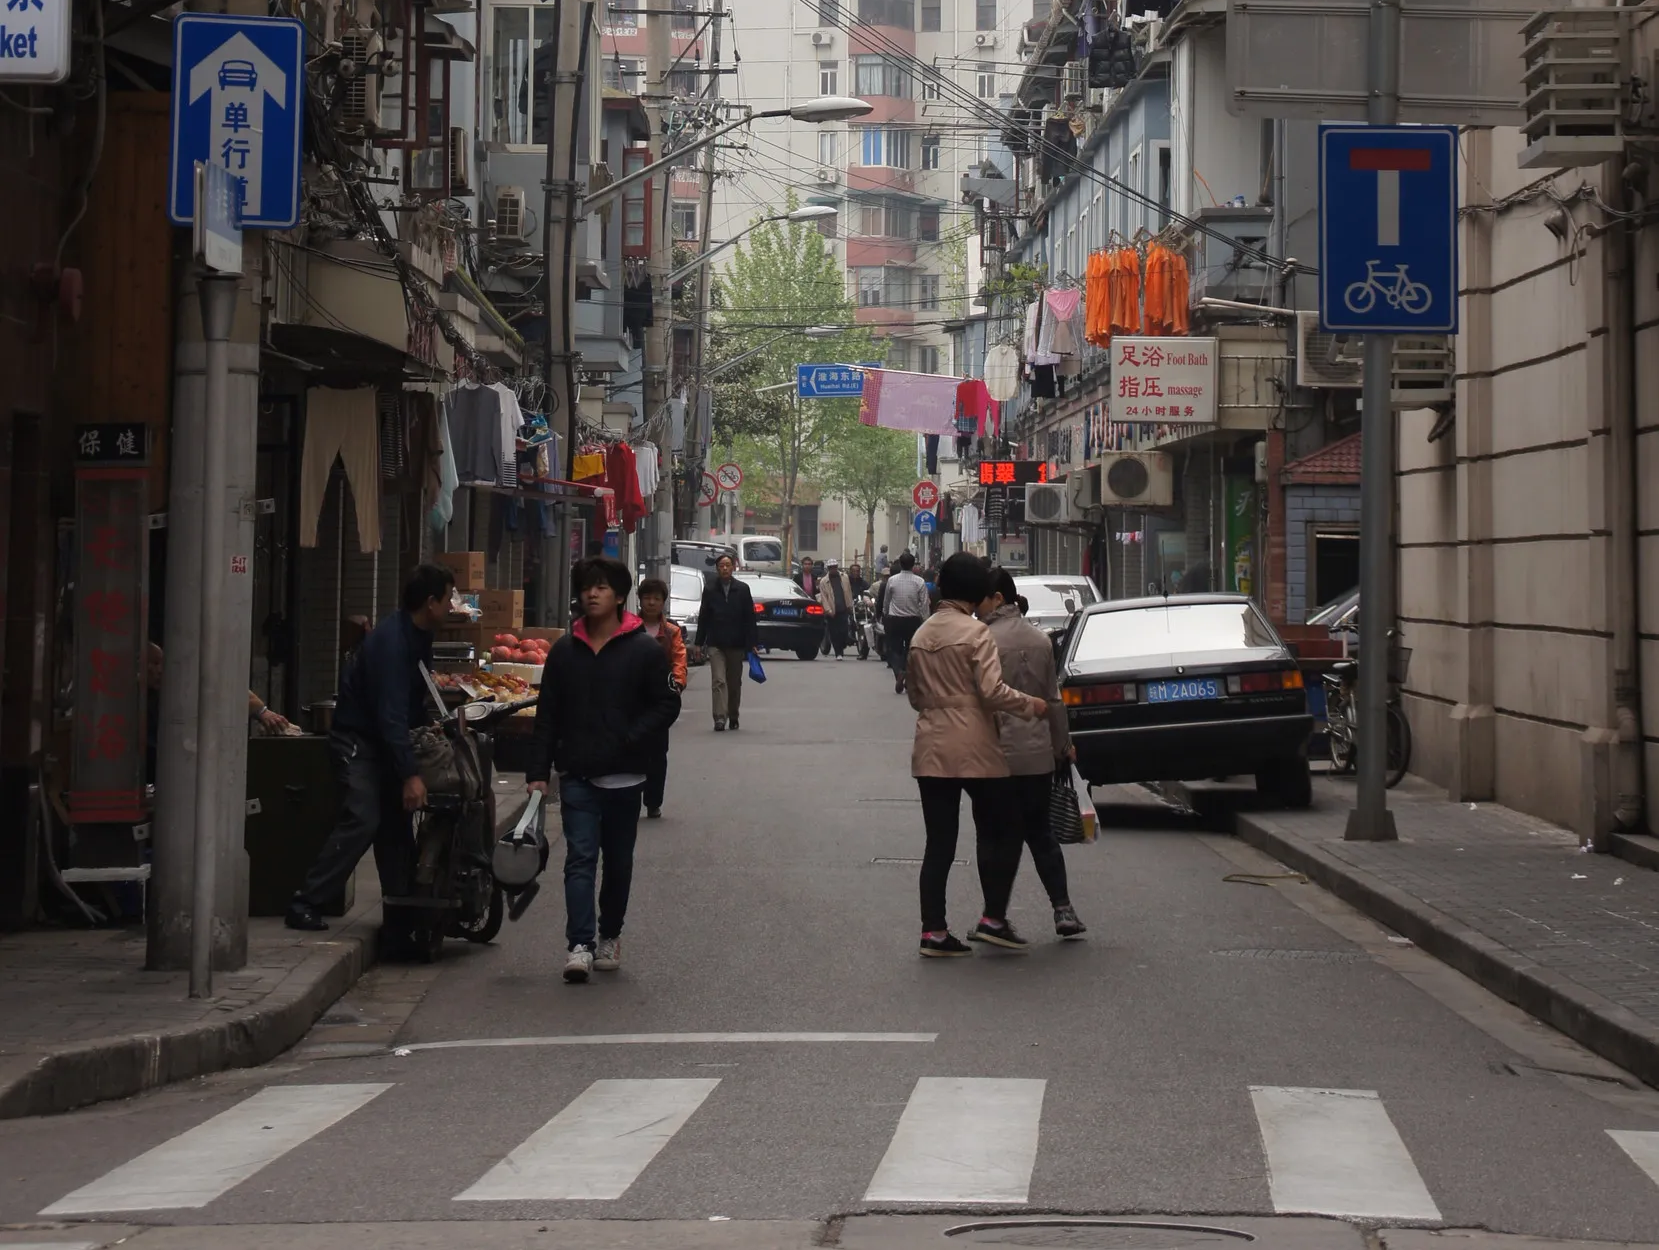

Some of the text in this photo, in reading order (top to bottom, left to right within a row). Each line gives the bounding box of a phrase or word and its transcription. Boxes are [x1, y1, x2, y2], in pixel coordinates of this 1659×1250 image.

[1118, 345, 1164, 367] 足浴
[1166, 352, 1208, 366] Foot Bath
[818, 372, 861, 381] 淮海东路
[1118, 375, 1164, 398] 指压
[1167, 385, 1203, 398] massage
[1125, 405, 1195, 417] 24小时服务
[78, 428, 141, 456] 保健
[918, 486, 934, 505] 停
